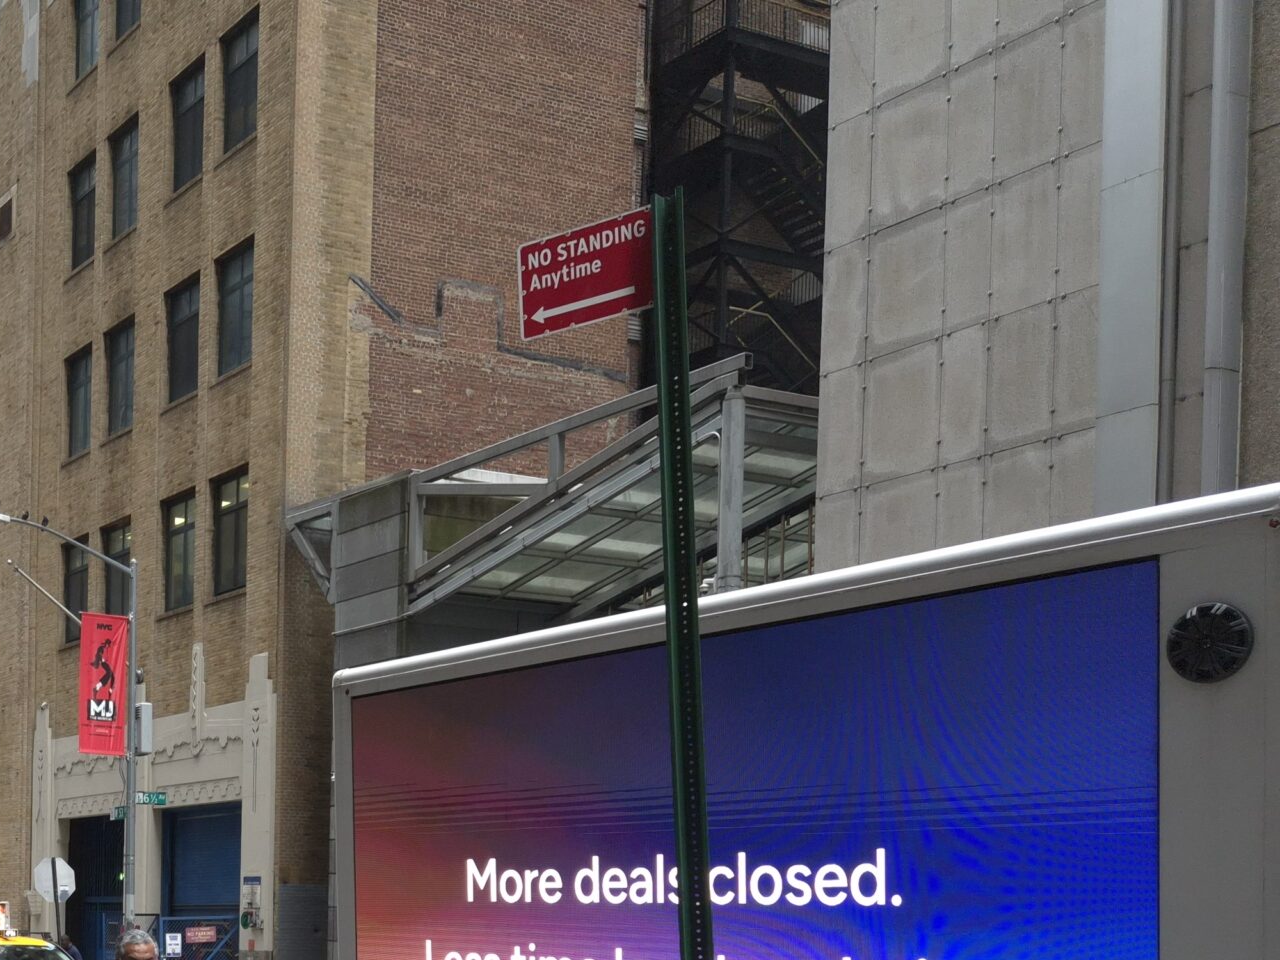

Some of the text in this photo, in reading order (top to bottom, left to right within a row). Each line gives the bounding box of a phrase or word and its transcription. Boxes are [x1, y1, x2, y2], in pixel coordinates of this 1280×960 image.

[528, 219, 646, 270] NO STANDING
[530, 259, 602, 292] Anytime
[90, 699, 114, 718] MJ
[466, 857, 564, 905] More
[708, 849, 903, 908] closed.
